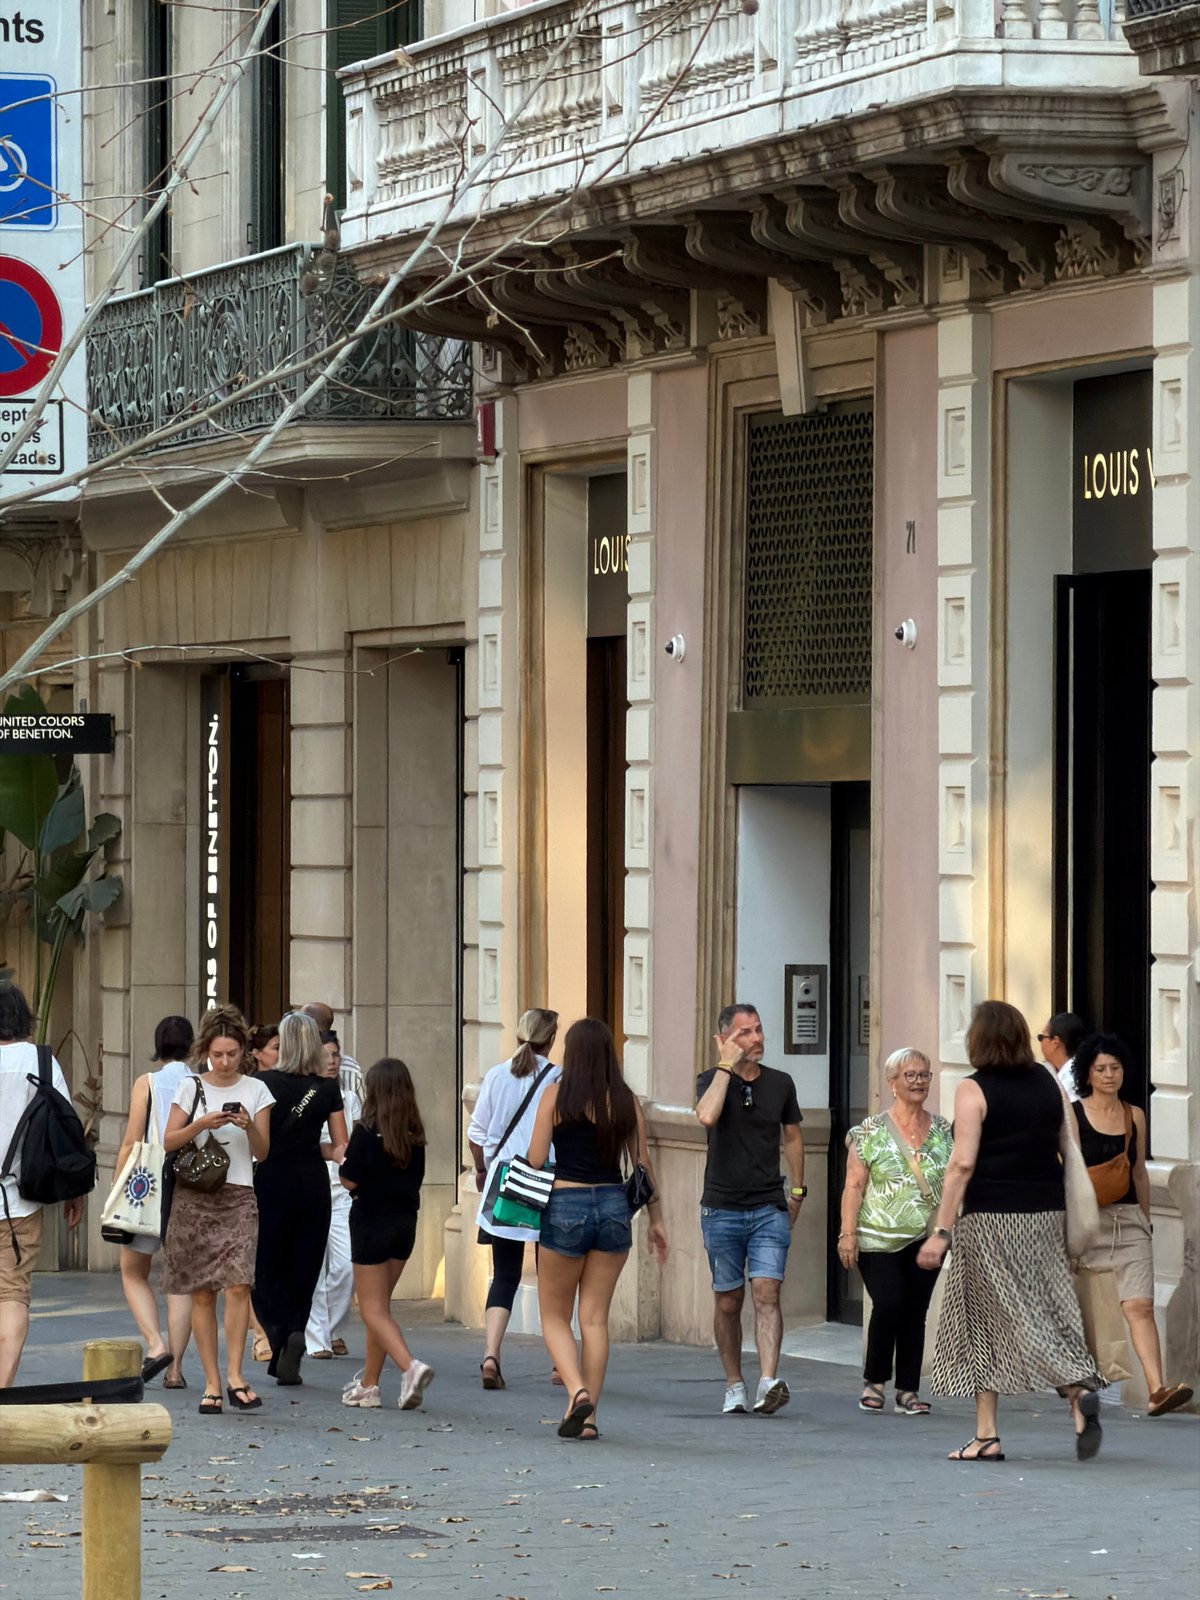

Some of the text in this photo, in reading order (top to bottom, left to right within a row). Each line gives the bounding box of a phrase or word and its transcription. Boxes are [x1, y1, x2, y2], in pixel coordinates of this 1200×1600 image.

[1084, 448, 1139, 499] LOUIS
[38, 716, 85, 727] COLORS
[12, 728, 74, 739] BENETTON.
